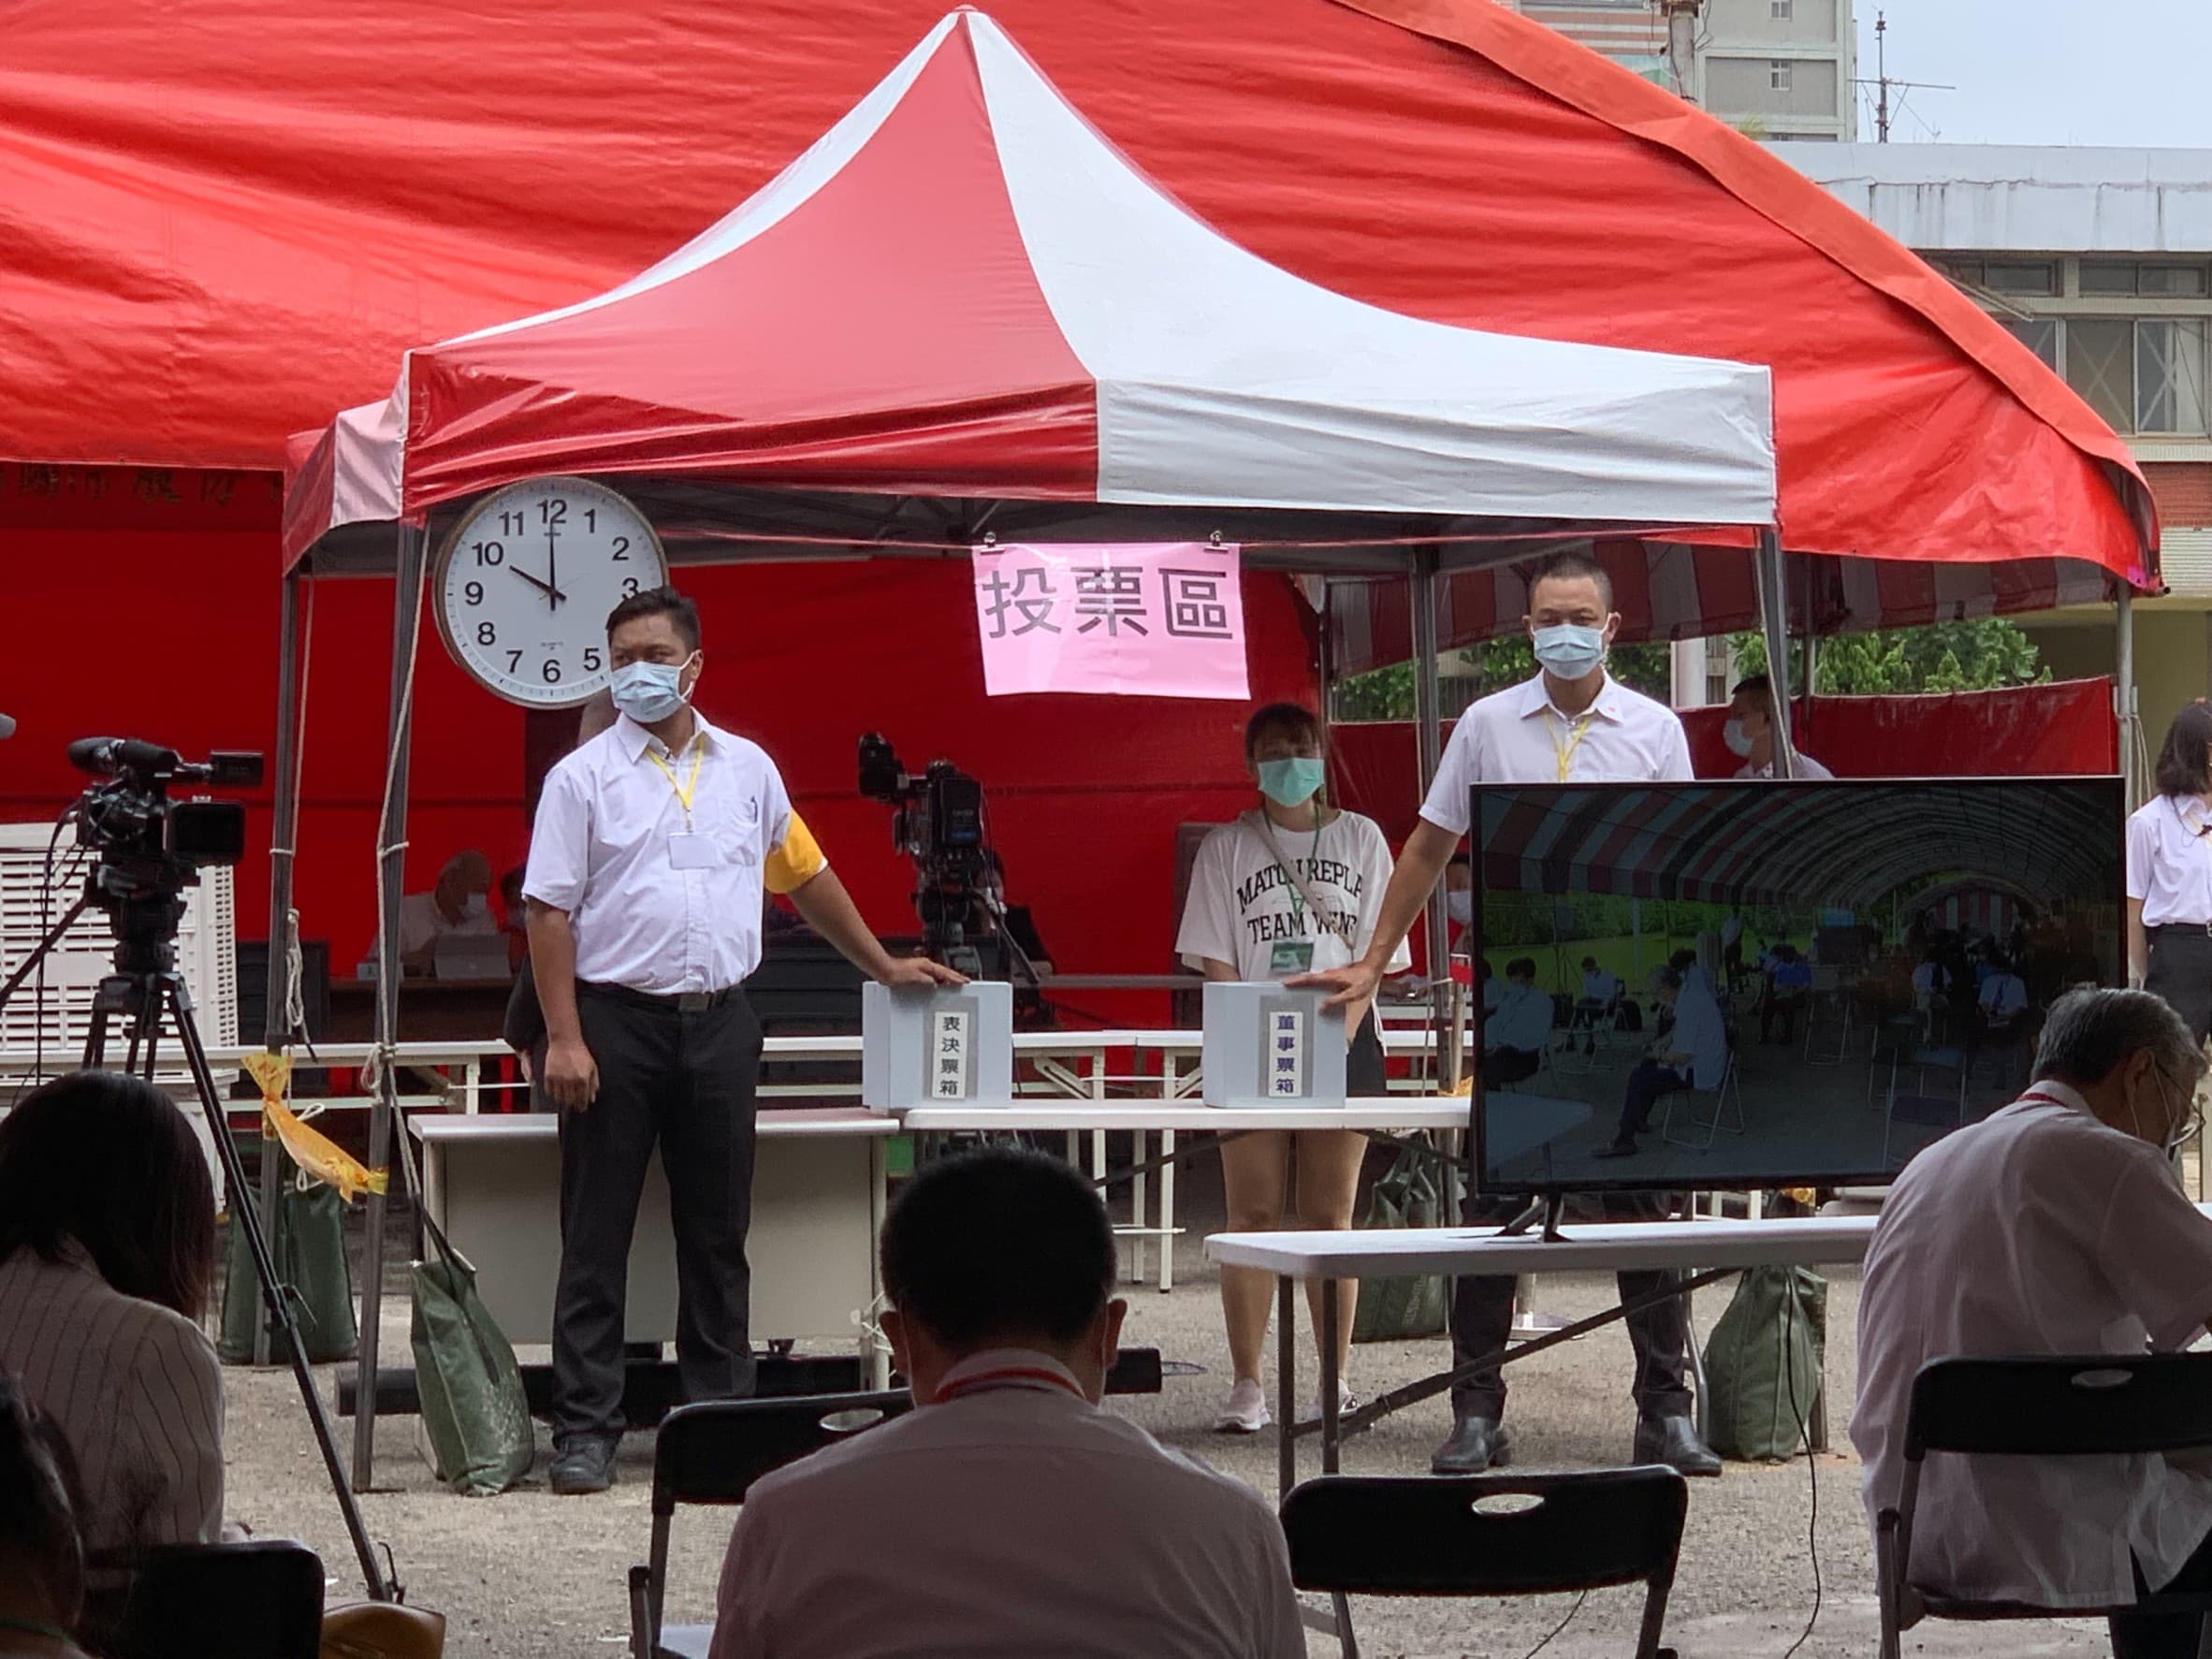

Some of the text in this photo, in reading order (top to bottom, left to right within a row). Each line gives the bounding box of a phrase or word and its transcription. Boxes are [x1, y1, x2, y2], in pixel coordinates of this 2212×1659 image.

[499, 511, 524, 536] 11
[537, 499, 567, 524] 12
[584, 508, 596, 533] 1
[472, 541, 504, 566] 10
[612, 536, 630, 561] 2
[464, 581, 484, 605] 9
[621, 577, 639, 600] 3
[982, 566, 1232, 639] 投票區
[477, 621, 496, 646] 8
[506, 649, 523, 674] 7
[543, 659, 560, 683] 6
[583, 648, 601, 672] 5
[1247, 911, 1306, 945] TEAM
[939, 1016, 961, 1096] 表決票箱
[1275, 1015, 1295, 1094] 董事票箱
